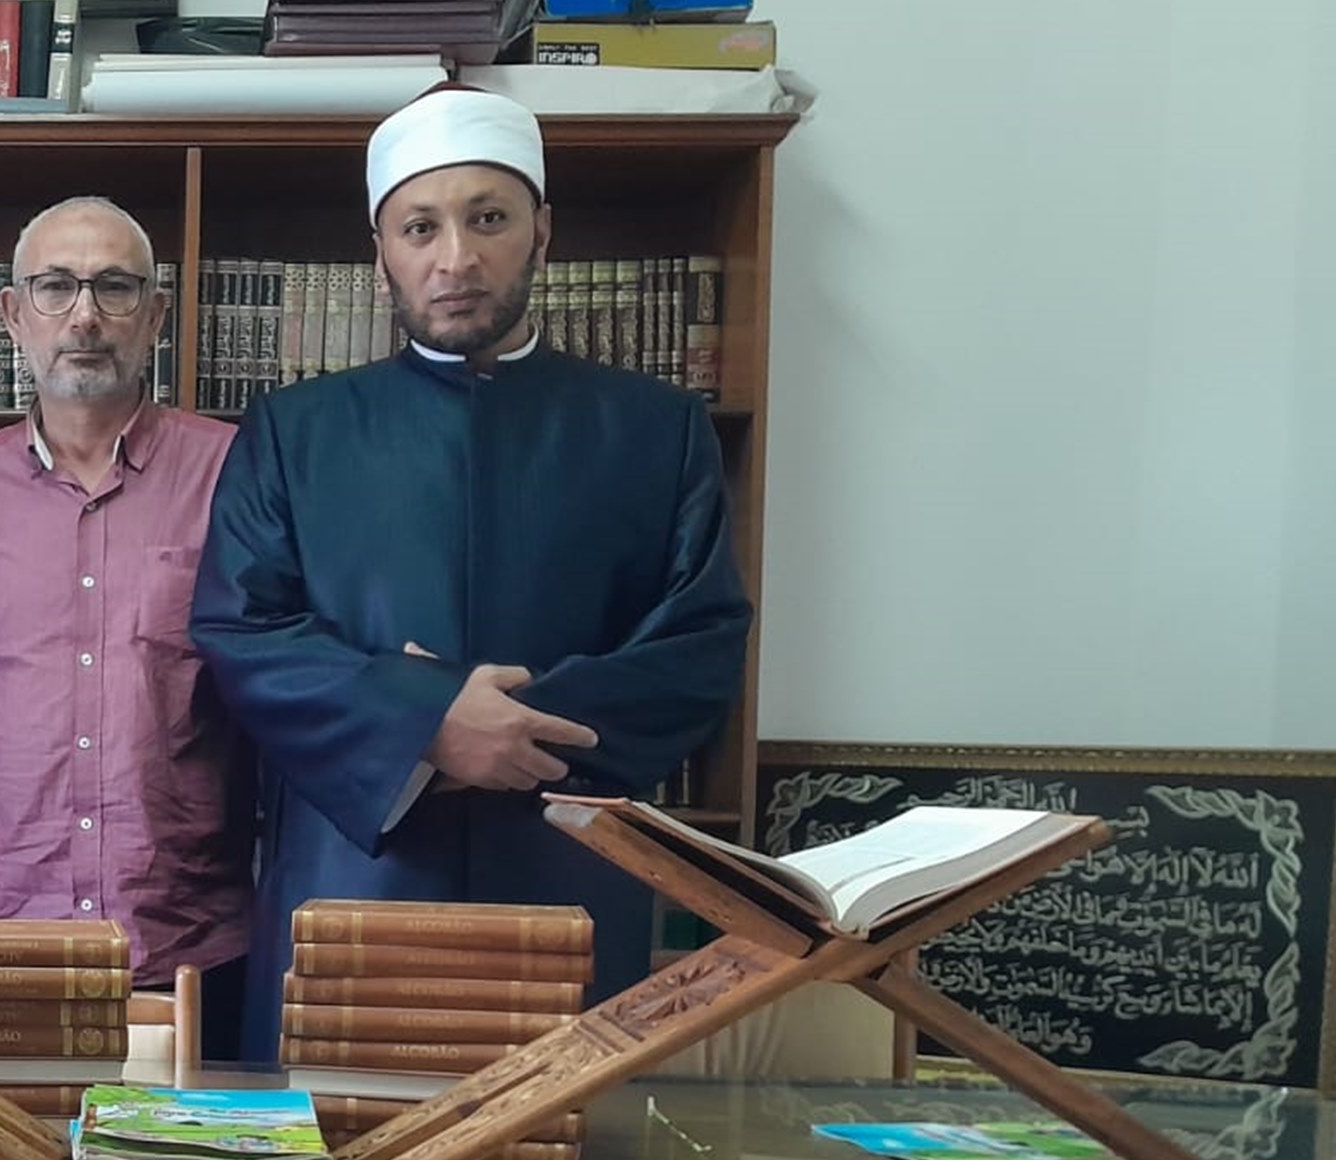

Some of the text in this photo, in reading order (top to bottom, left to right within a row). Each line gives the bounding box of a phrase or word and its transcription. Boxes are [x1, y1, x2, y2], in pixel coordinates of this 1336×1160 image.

[538, 52, 598, 65] INSPIRO
[1034, 782, 1077, 811] الله
[1188, 847, 1215, 888] لا
[1213, 852, 1259, 888] الله
